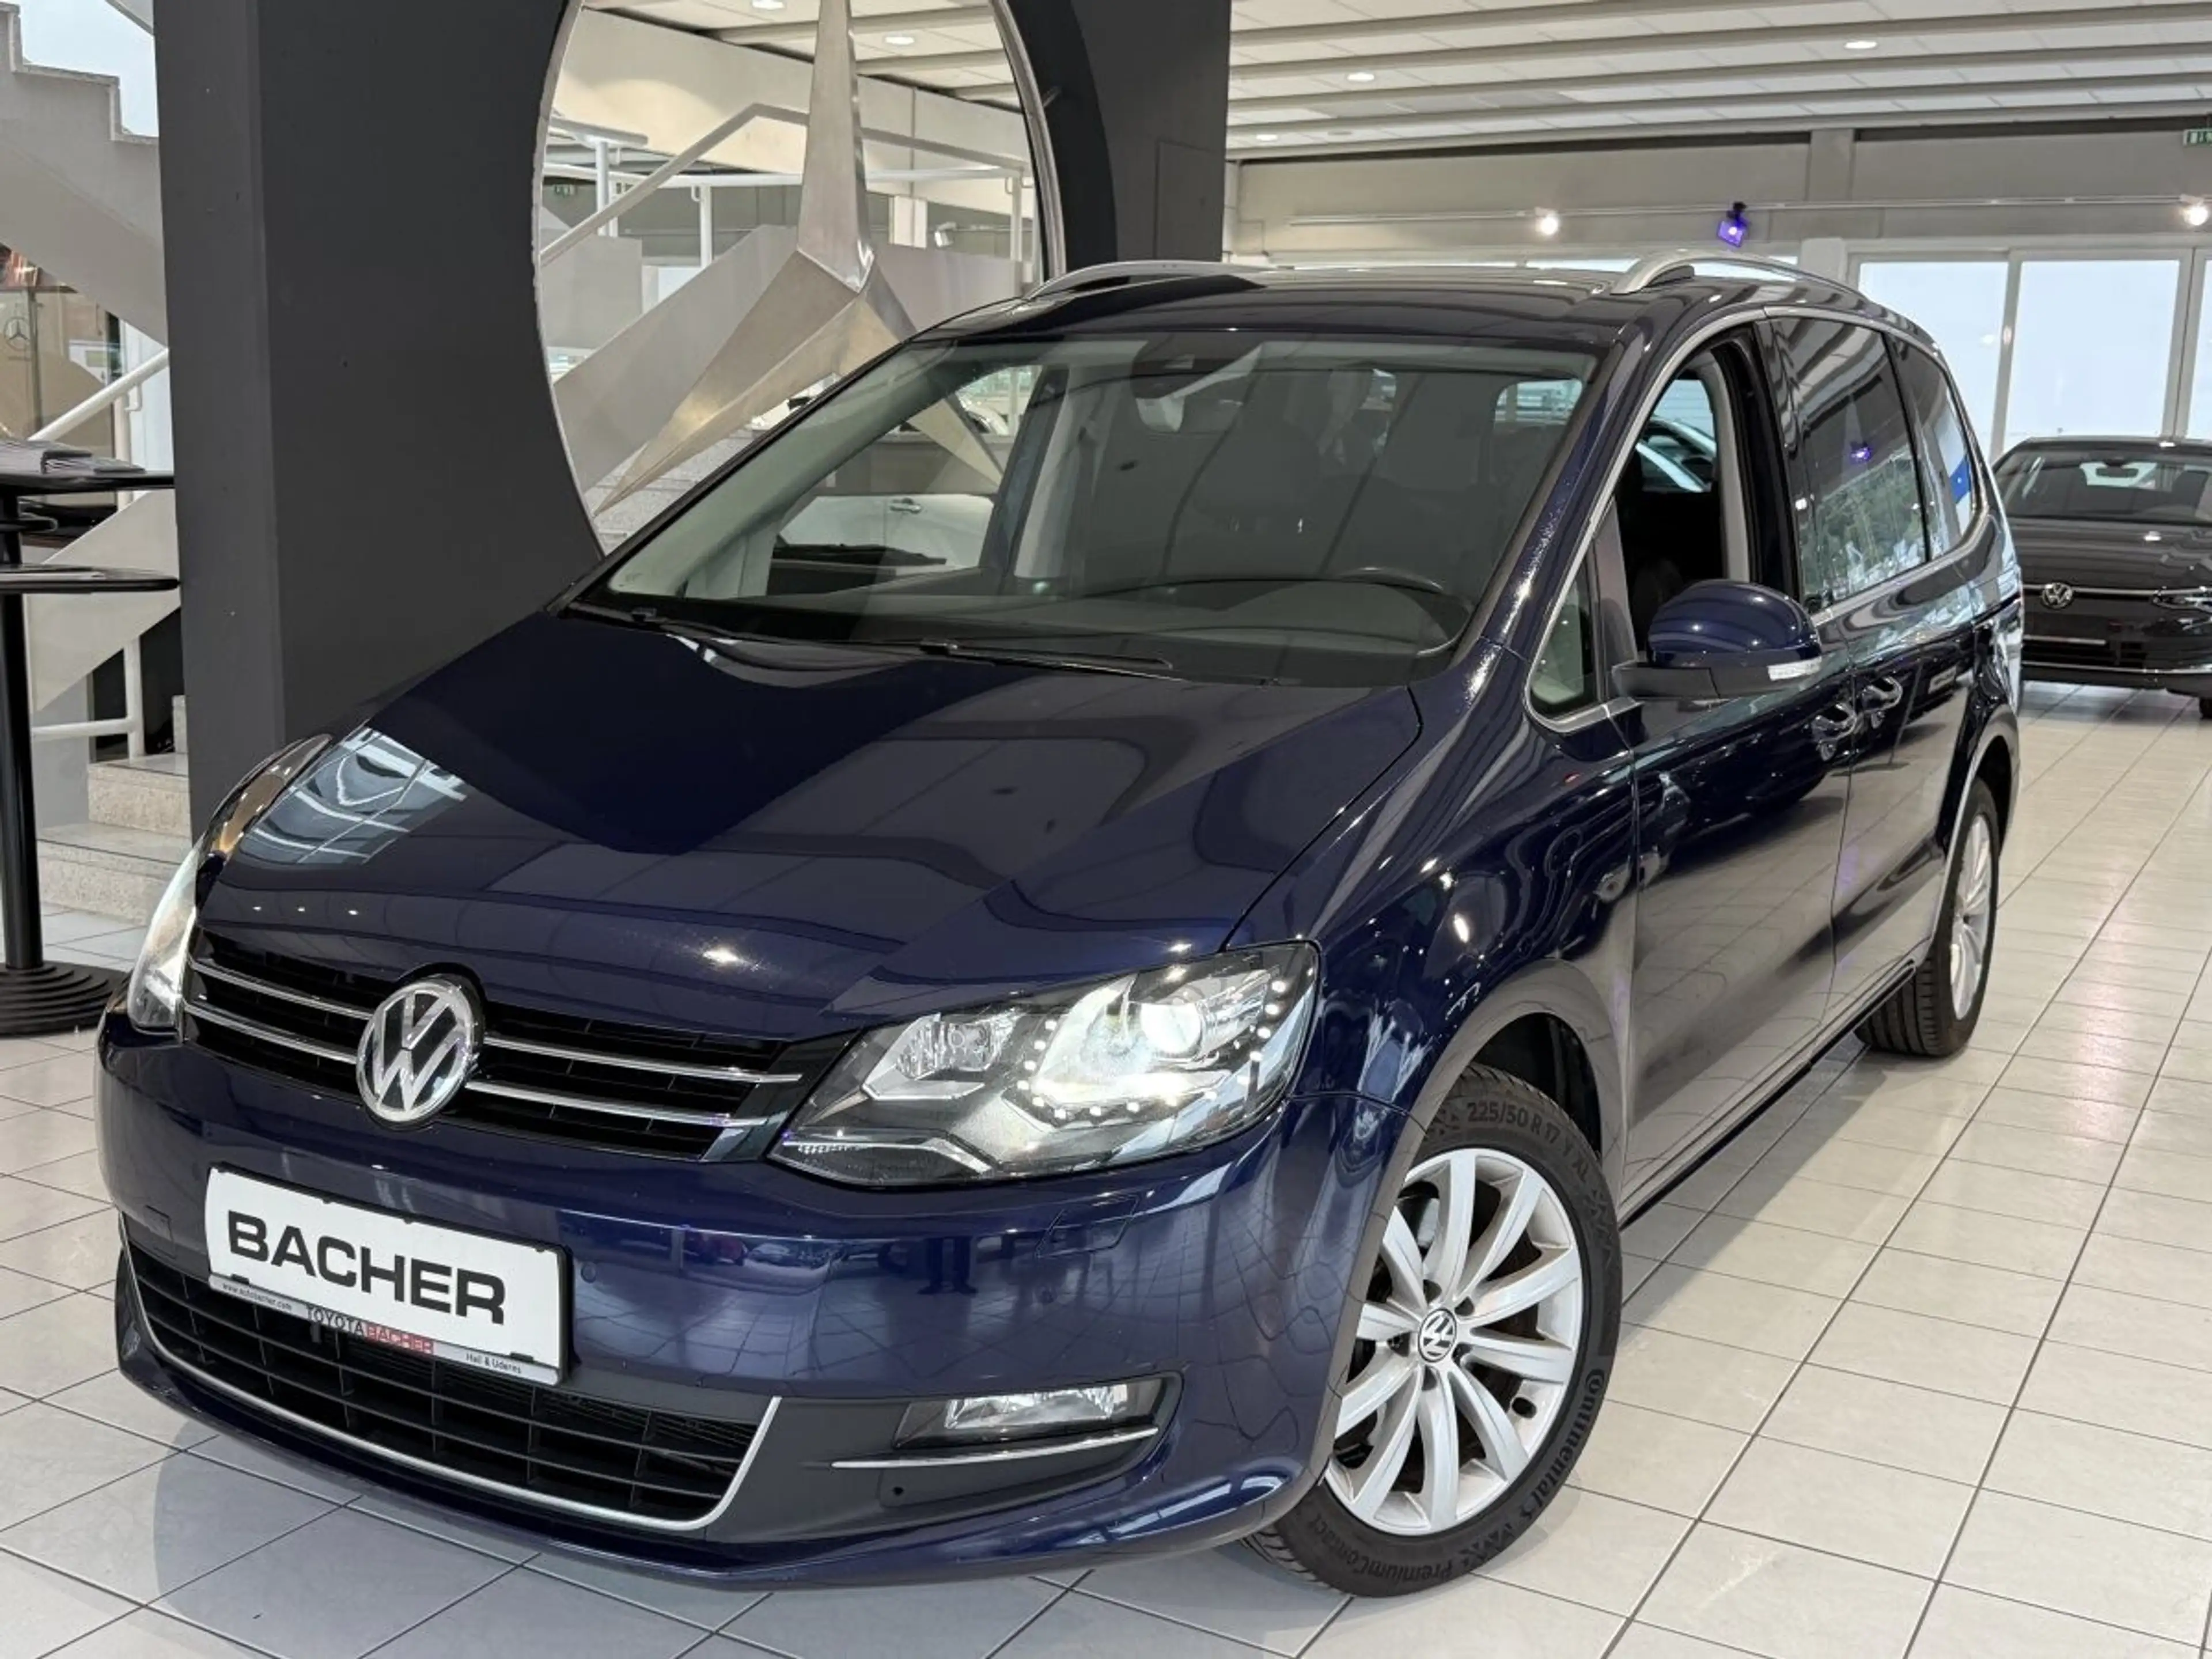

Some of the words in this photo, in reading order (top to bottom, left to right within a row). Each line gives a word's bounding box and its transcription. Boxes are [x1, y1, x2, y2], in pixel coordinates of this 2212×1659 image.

[1467, 1101, 1528, 1127] 225/50
[1531, 1113, 1543, 1135] R
[228, 1210, 506, 1325] BACHER
[1531, 1368, 1605, 1508] Continental
